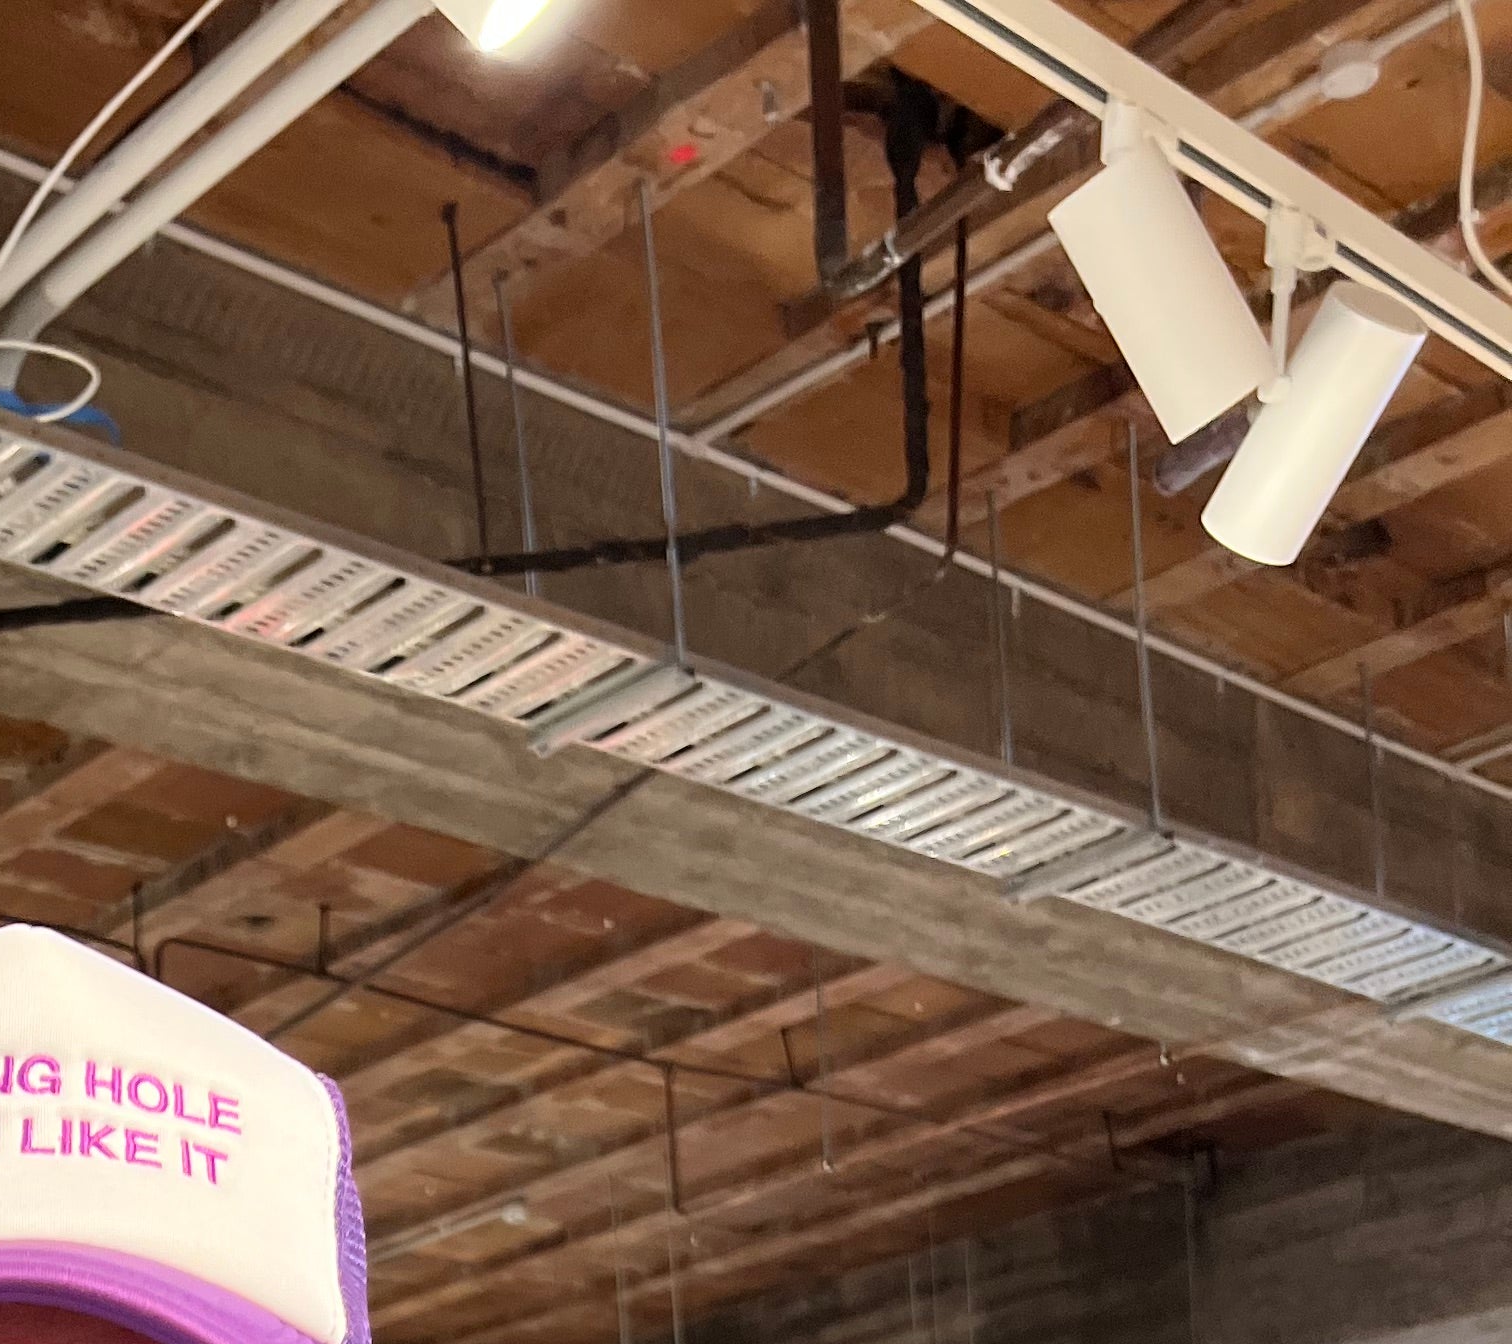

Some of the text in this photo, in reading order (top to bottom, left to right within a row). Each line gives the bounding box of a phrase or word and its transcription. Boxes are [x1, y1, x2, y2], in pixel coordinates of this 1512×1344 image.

[85, 1060, 242, 1134] HOLE
[20, 1118, 163, 1168] LIKE
[180, 1139, 229, 1185] IT
